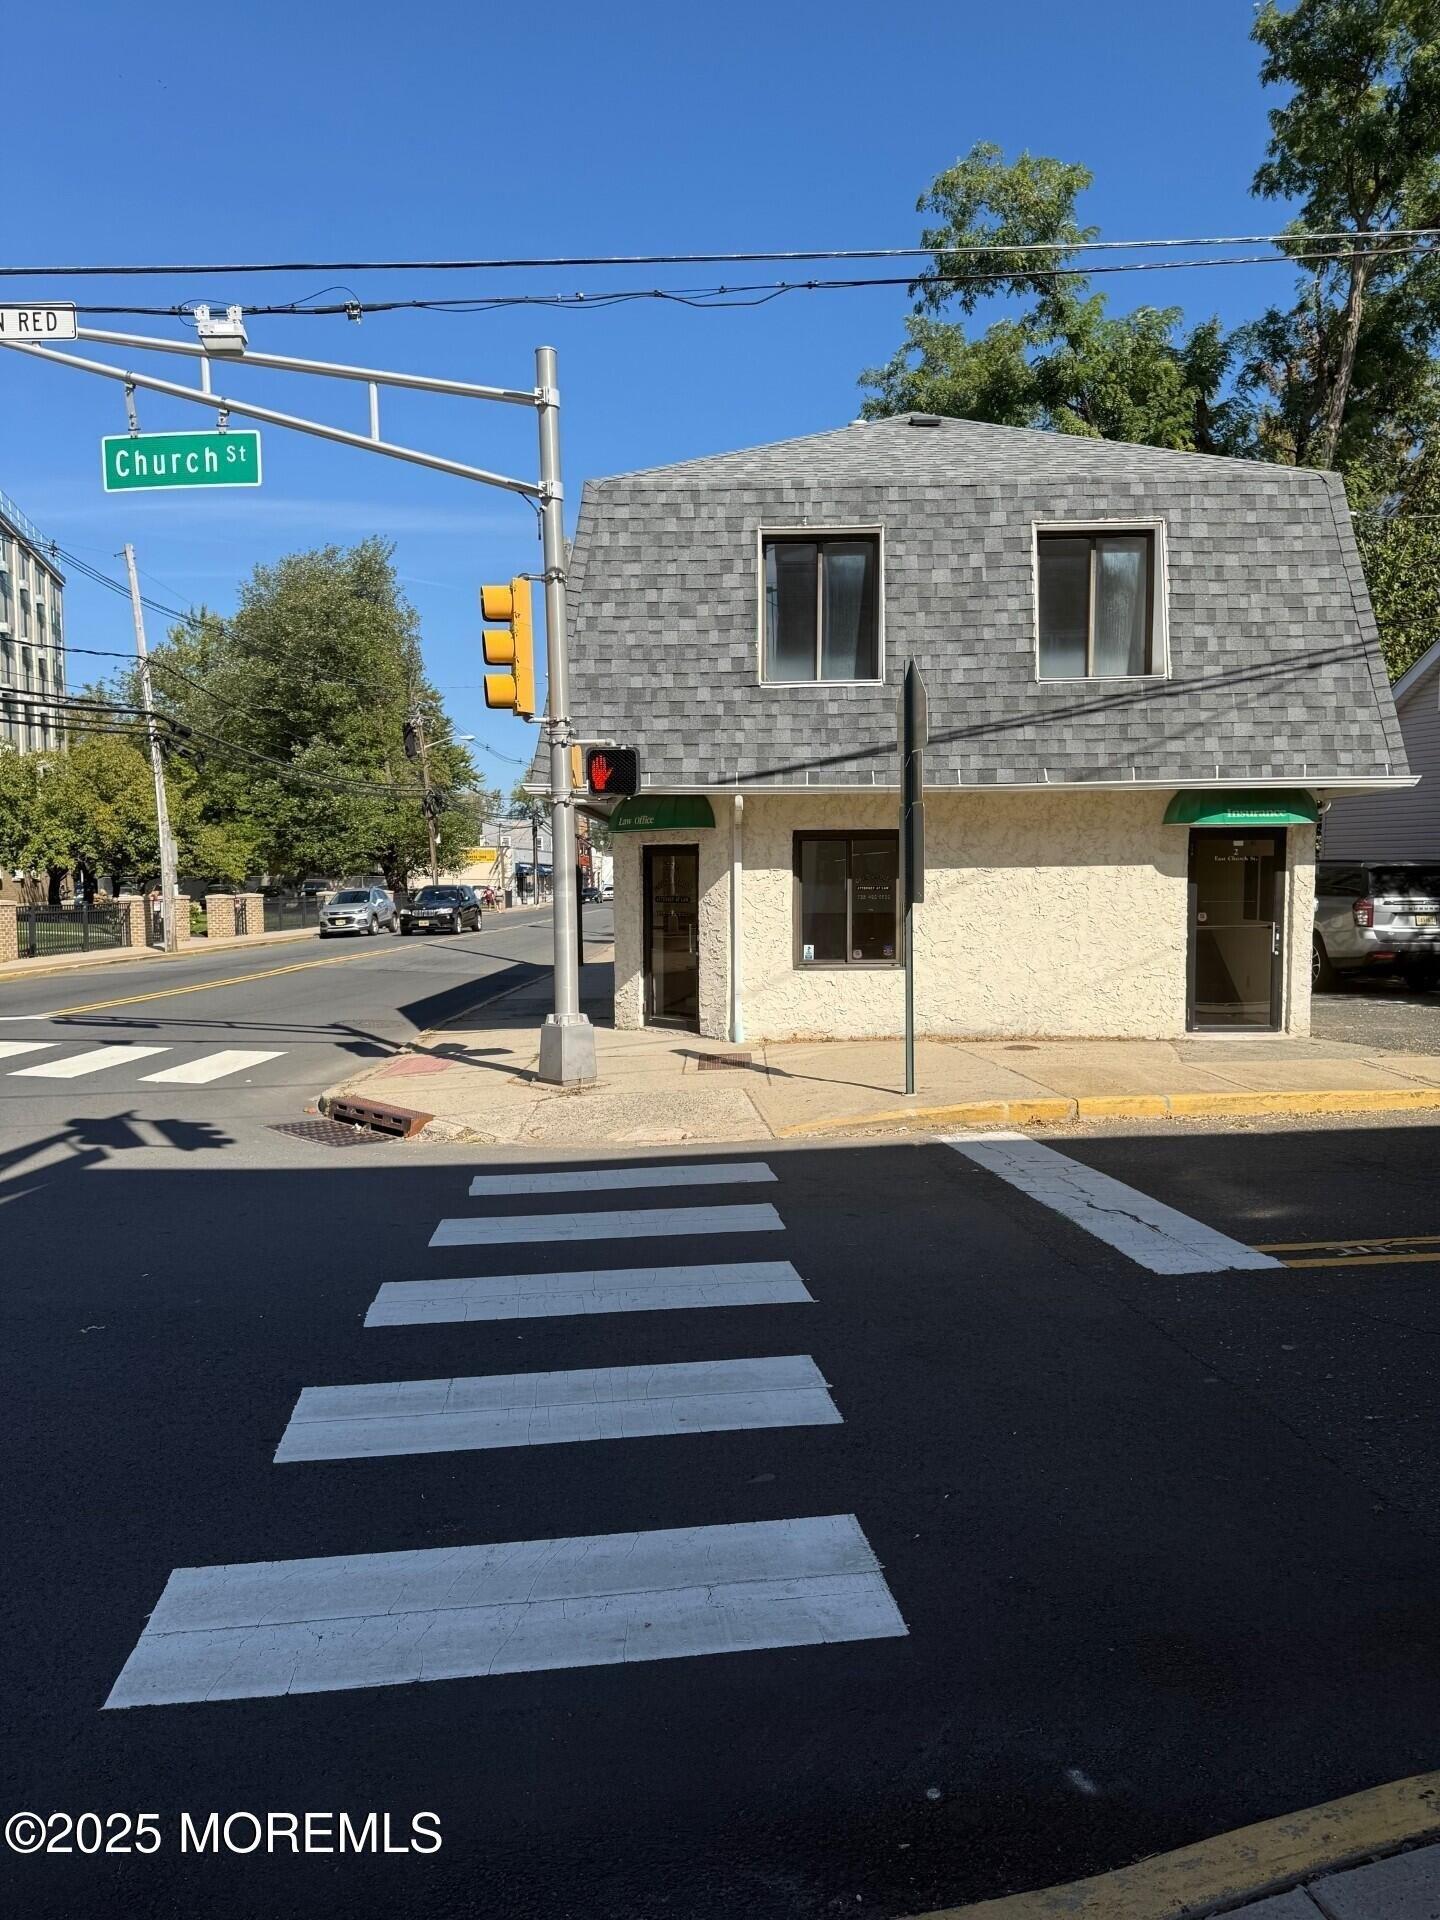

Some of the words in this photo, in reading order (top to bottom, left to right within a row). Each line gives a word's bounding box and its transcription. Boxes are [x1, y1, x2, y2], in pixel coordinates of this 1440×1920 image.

[18, 311, 57, 332] RED
[115, 447, 218, 477] Church
[226, 445, 247, 463] St
[1227, 808, 1286, 817] Insurance
[618, 817, 632, 825] Law
[634, 815, 655, 825] Office
[1233, 848, 1239, 856] 2
